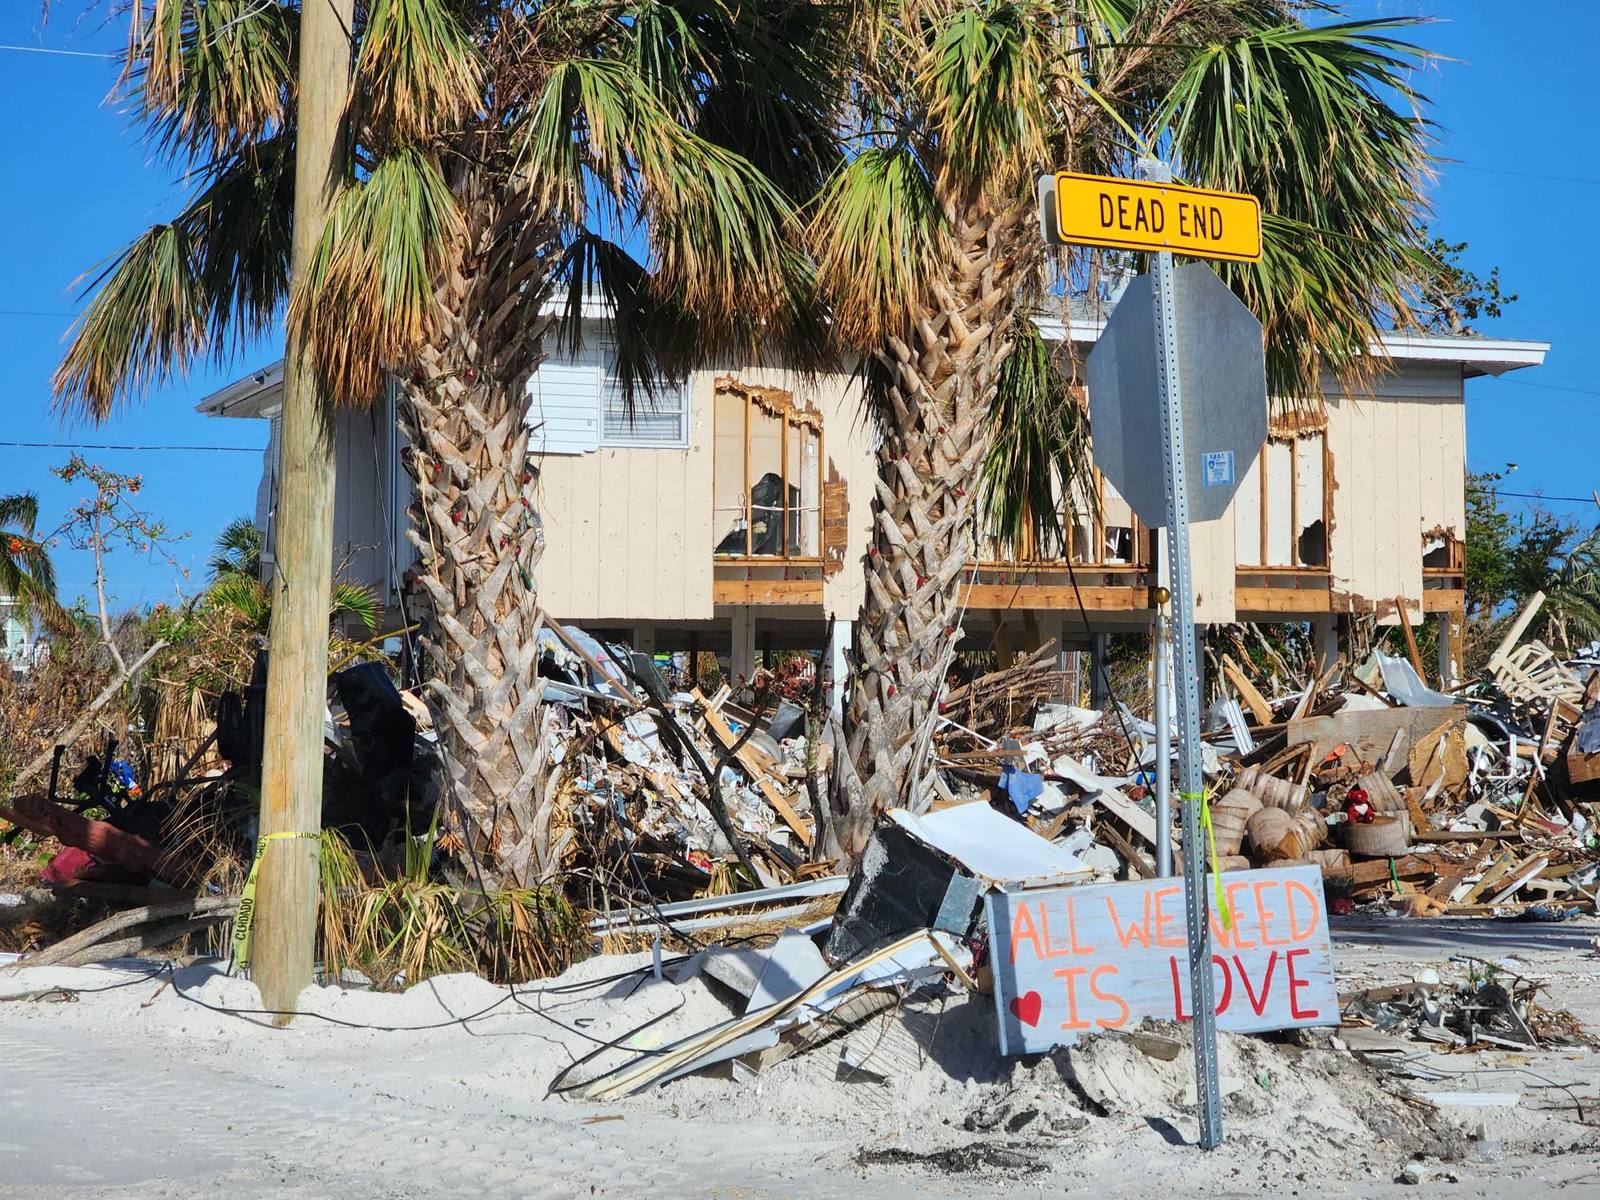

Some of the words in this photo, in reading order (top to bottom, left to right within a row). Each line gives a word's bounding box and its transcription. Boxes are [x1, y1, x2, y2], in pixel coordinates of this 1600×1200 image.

[1099, 193, 1165, 234] DEAD
[1179, 203, 1223, 241] END
[235, 897, 254, 941] CUIDADO
[1009, 896, 1095, 965] ALL
[1105, 887, 1189, 949] WE
[1054, 965, 1130, 1031] IS
